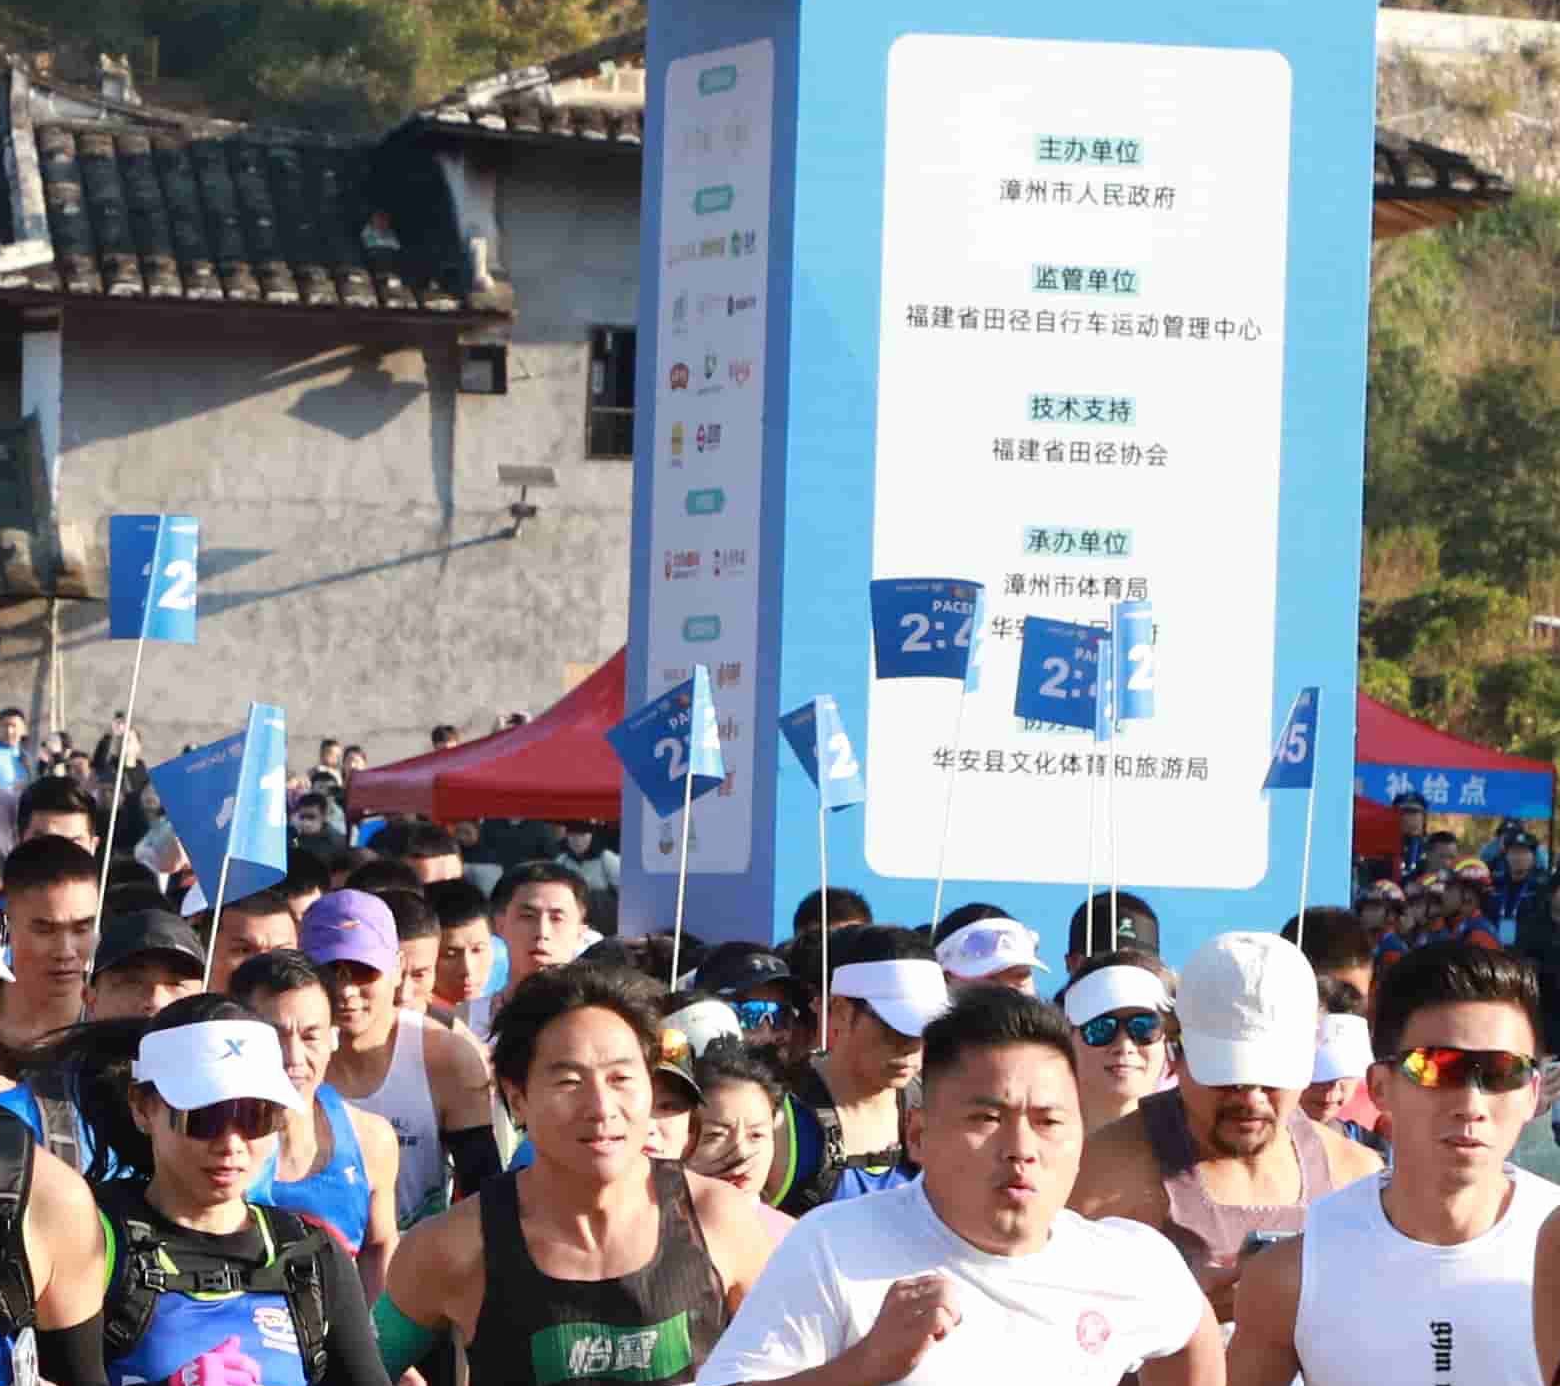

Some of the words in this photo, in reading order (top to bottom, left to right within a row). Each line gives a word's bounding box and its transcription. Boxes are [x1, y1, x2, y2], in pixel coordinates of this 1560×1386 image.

[1039, 137, 1140, 164] 主办单位
[999, 179, 1176, 210] 漳州市人民政府
[1034, 266, 1136, 293] 监管单位
[905, 304, 1263, 341] 福建省田径自行车运动管理中心
[1031, 397, 1132, 424] 技术支持
[992, 438, 1168, 467] 福建省田径协会
[1027, 529, 1129, 555] 承办单位
[1004, 573, 1149, 600] 漳州市体育局
[932, 748, 1209, 781] 华安县文化体育和旅游局
[1386, 772, 1488, 806] 补给点
[568, 1330, 658, 1375] 怡寶
